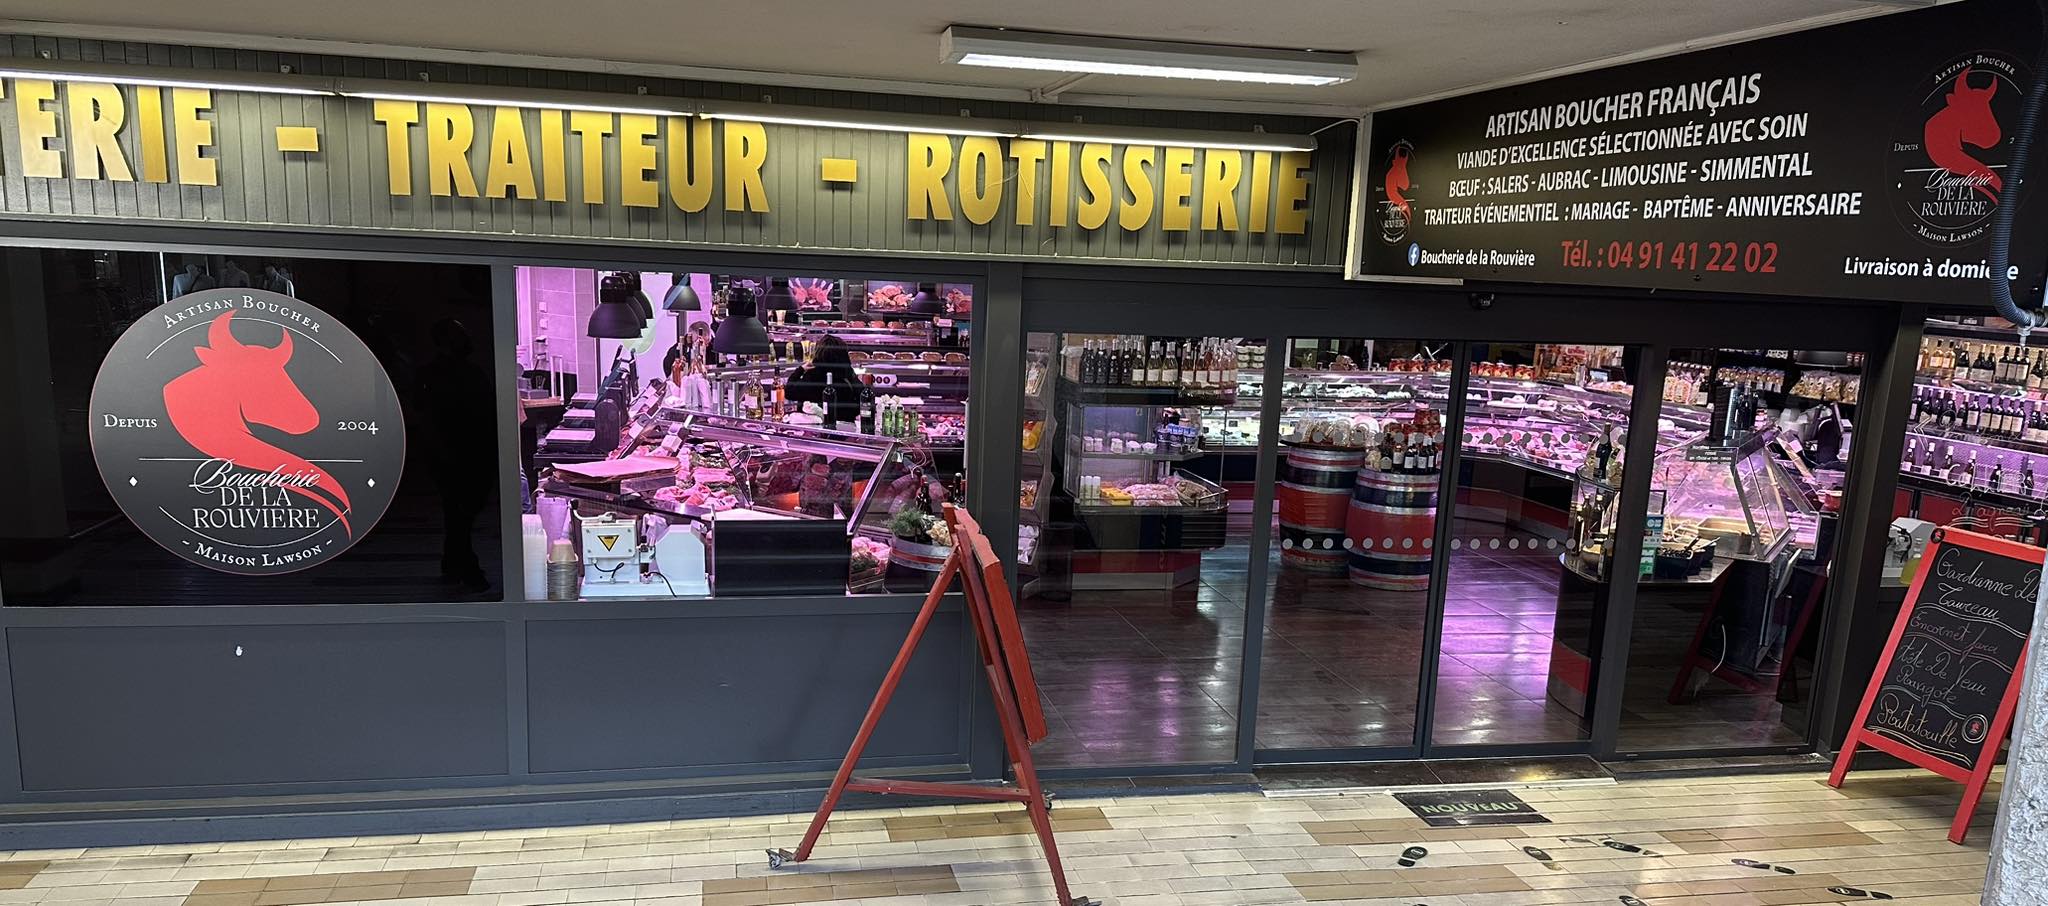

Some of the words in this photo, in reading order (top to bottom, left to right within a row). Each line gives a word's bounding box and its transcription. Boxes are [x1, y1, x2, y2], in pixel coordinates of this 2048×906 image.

[1934, 58, 1972, 84] ARTISAN
[1976, 54, 2016, 76] BOUCHER
[1485, 105, 1552, 139] ARTISAN
[1554, 91, 1643, 129] BOUCHER
[1647, 73, 1762, 117] FRANÇAIS
[1457, 149, 1497, 170] VIANDE
[1499, 138, 1586, 166] D'EXCELLENCE
[1589, 120, 1704, 156] SÉLECTIONNÉE
[1706, 118, 1756, 146] AVEC
[1758, 112, 1808, 141] SOIN
[1893, 142, 1919, 152] DEPUIS
[0, 78, 218, 186] ERIE
[374, 100, 770, 214] TRAITEUR
[908, 131, 1311, 234] ROTISSERIE
[1449, 180, 1480, 198] BŒUF
[1487, 174, 1529, 195] SALERS
[1537, 169, 1591, 191] AUBRAC
[1601, 161, 1688, 188] LIMOUSINE
[1700, 152, 1813, 182] SIMMENTAL
[1924, 168, 1993, 194] Boucherie
[1937, 186, 1955, 201] DE
[1958, 186, 1974, 201] LA
[1424, 207, 1472, 226] TRAITEUR
[1473, 201, 1559, 224] ÉVÉNEMENTIEL
[1571, 201, 1630, 221] MARIAGE
[1643, 195, 1714, 219] BAPTÊME
[1725, 192, 1863, 217] ANNIVERSAIRE
[1921, 201, 1987, 216] ROUVIERE
[1917, 225, 1948, 242] MAISON
[1950, 227, 1983, 242] LAWSON
[1421, 249, 1464, 265] Boucherie
[1466, 249, 1478, 265] de
[1479, 250, 1489, 265] la
[1490, 249, 1535, 266] Rouvière
[1561, 239, 1592, 268] Tél.
[1608, 241, 1633, 269] 04
[1639, 241, 1664, 270] 91
[1671, 242, 1698, 270] 41
[1706, 242, 1737, 271] 22
[1745, 242, 1778, 272] 02
[1844, 256, 1919, 277] Livraison
[1922, 258, 1933, 277] à
[1937, 258, 2019, 280] domie
[163, 298, 234, 329] ARTISAN
[242, 295, 322, 333] BOUCHER
[103, 413, 158, 429] DEPUIS
[337, 420, 379, 435] 2004
[189, 457, 321, 495] Boucherie
[220, 486, 254, 507] DE
[261, 486, 292, 507] LA
[193, 508, 320, 529] ROUVIERE
[195, 543, 256, 567] MAISON
[262, 544, 322, 567] LAWSON
[1937, 548, 2014, 597] Gardianne
[1938, 582, 2000, 621] Taureau
[1955, 659, 1988, 696] Veau
[1420, 802, 1519, 814] NOUVEAU
